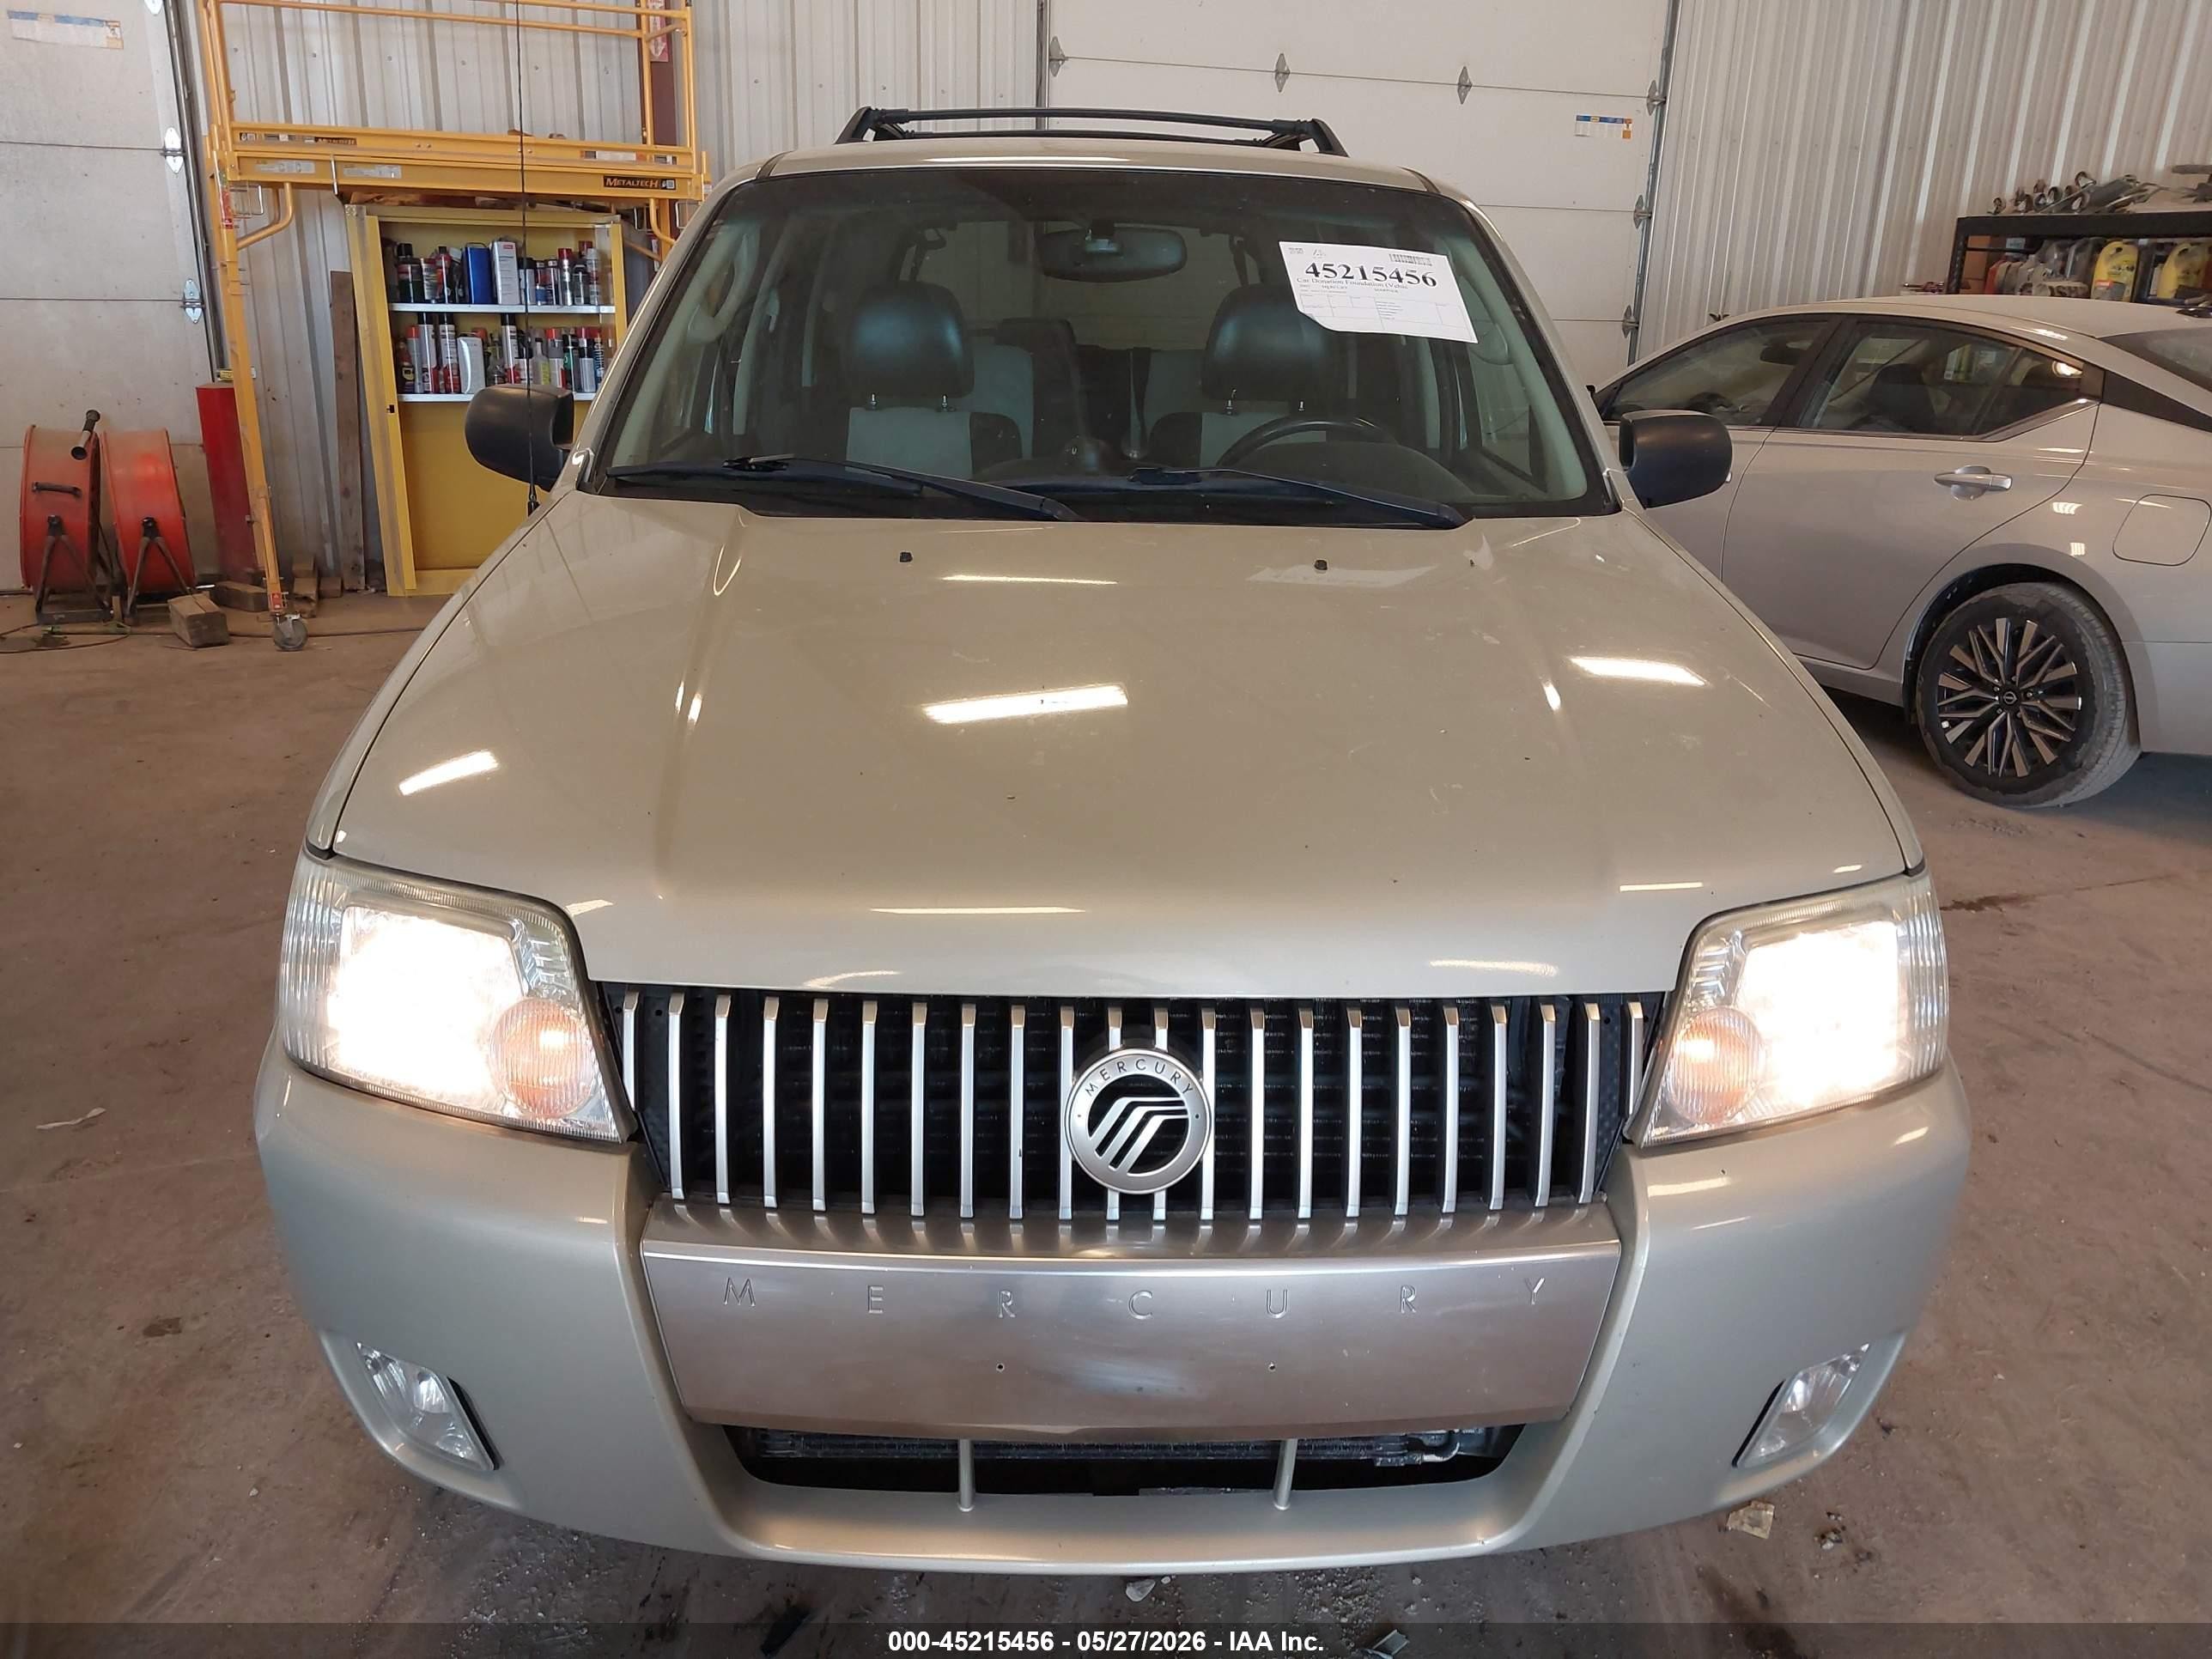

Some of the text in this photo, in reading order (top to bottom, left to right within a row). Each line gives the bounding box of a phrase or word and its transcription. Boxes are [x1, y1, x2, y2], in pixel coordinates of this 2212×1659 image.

[605, 178, 659, 189] METALTECH
[1305, 262, 1437, 288] 45215456
[1085, 1058, 1194, 1097] MERCURY
[723, 1276, 1546, 1320] MERCURY
